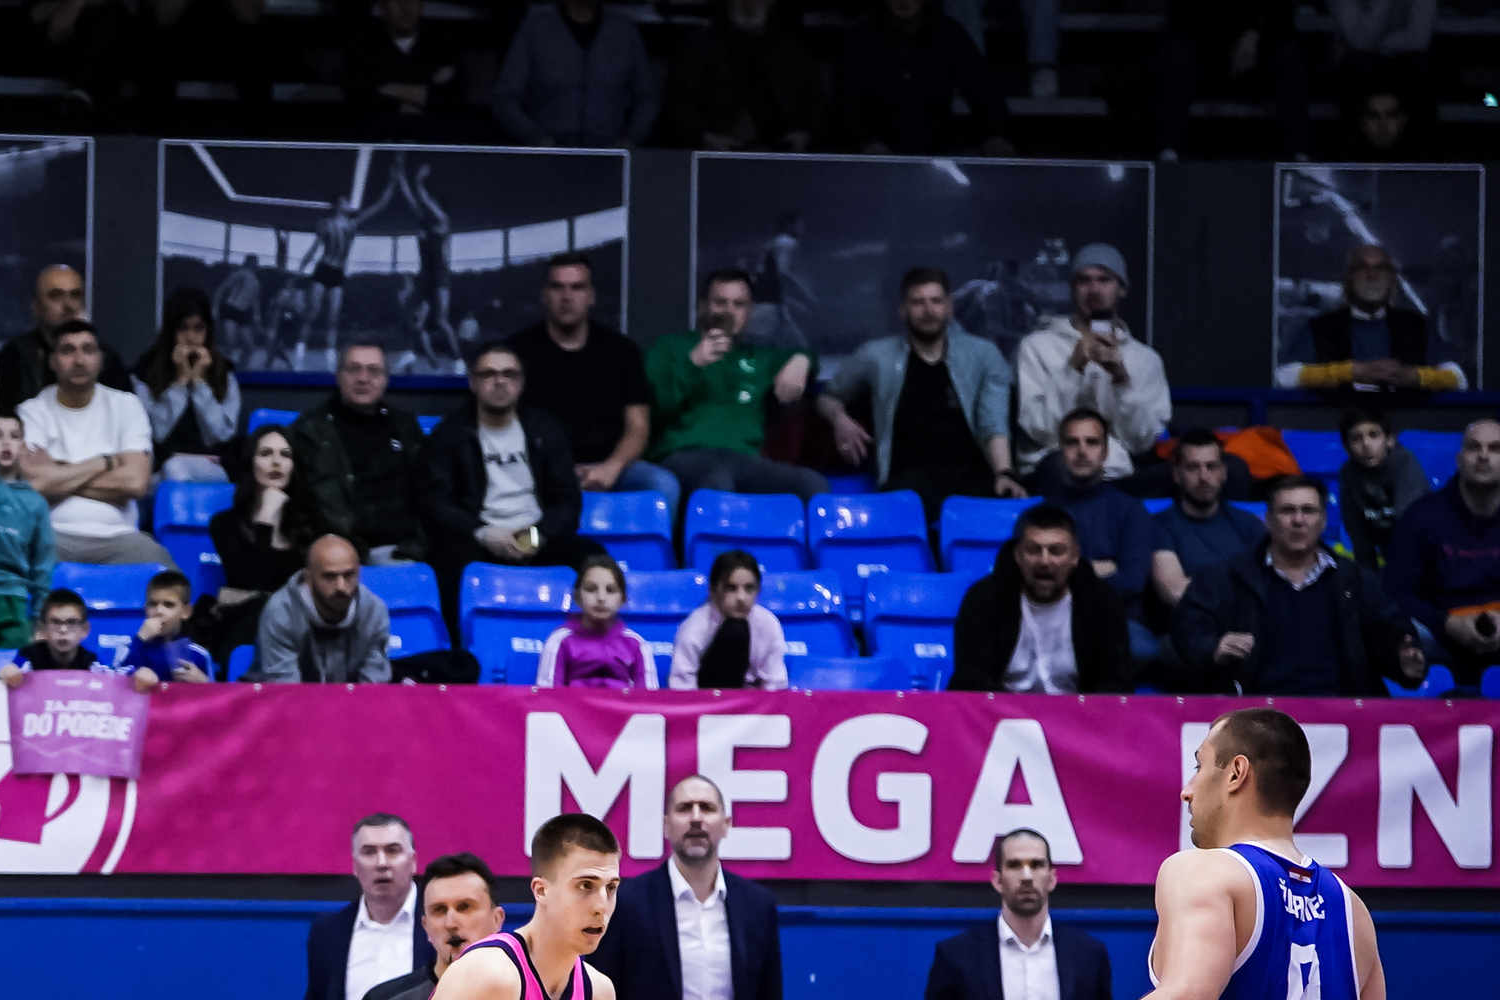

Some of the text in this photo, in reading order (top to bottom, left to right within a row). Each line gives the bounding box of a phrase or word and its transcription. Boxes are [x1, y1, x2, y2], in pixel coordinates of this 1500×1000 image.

[22, 711, 134, 742] DO POBEDE
[525, 712, 1083, 865] MEGA
